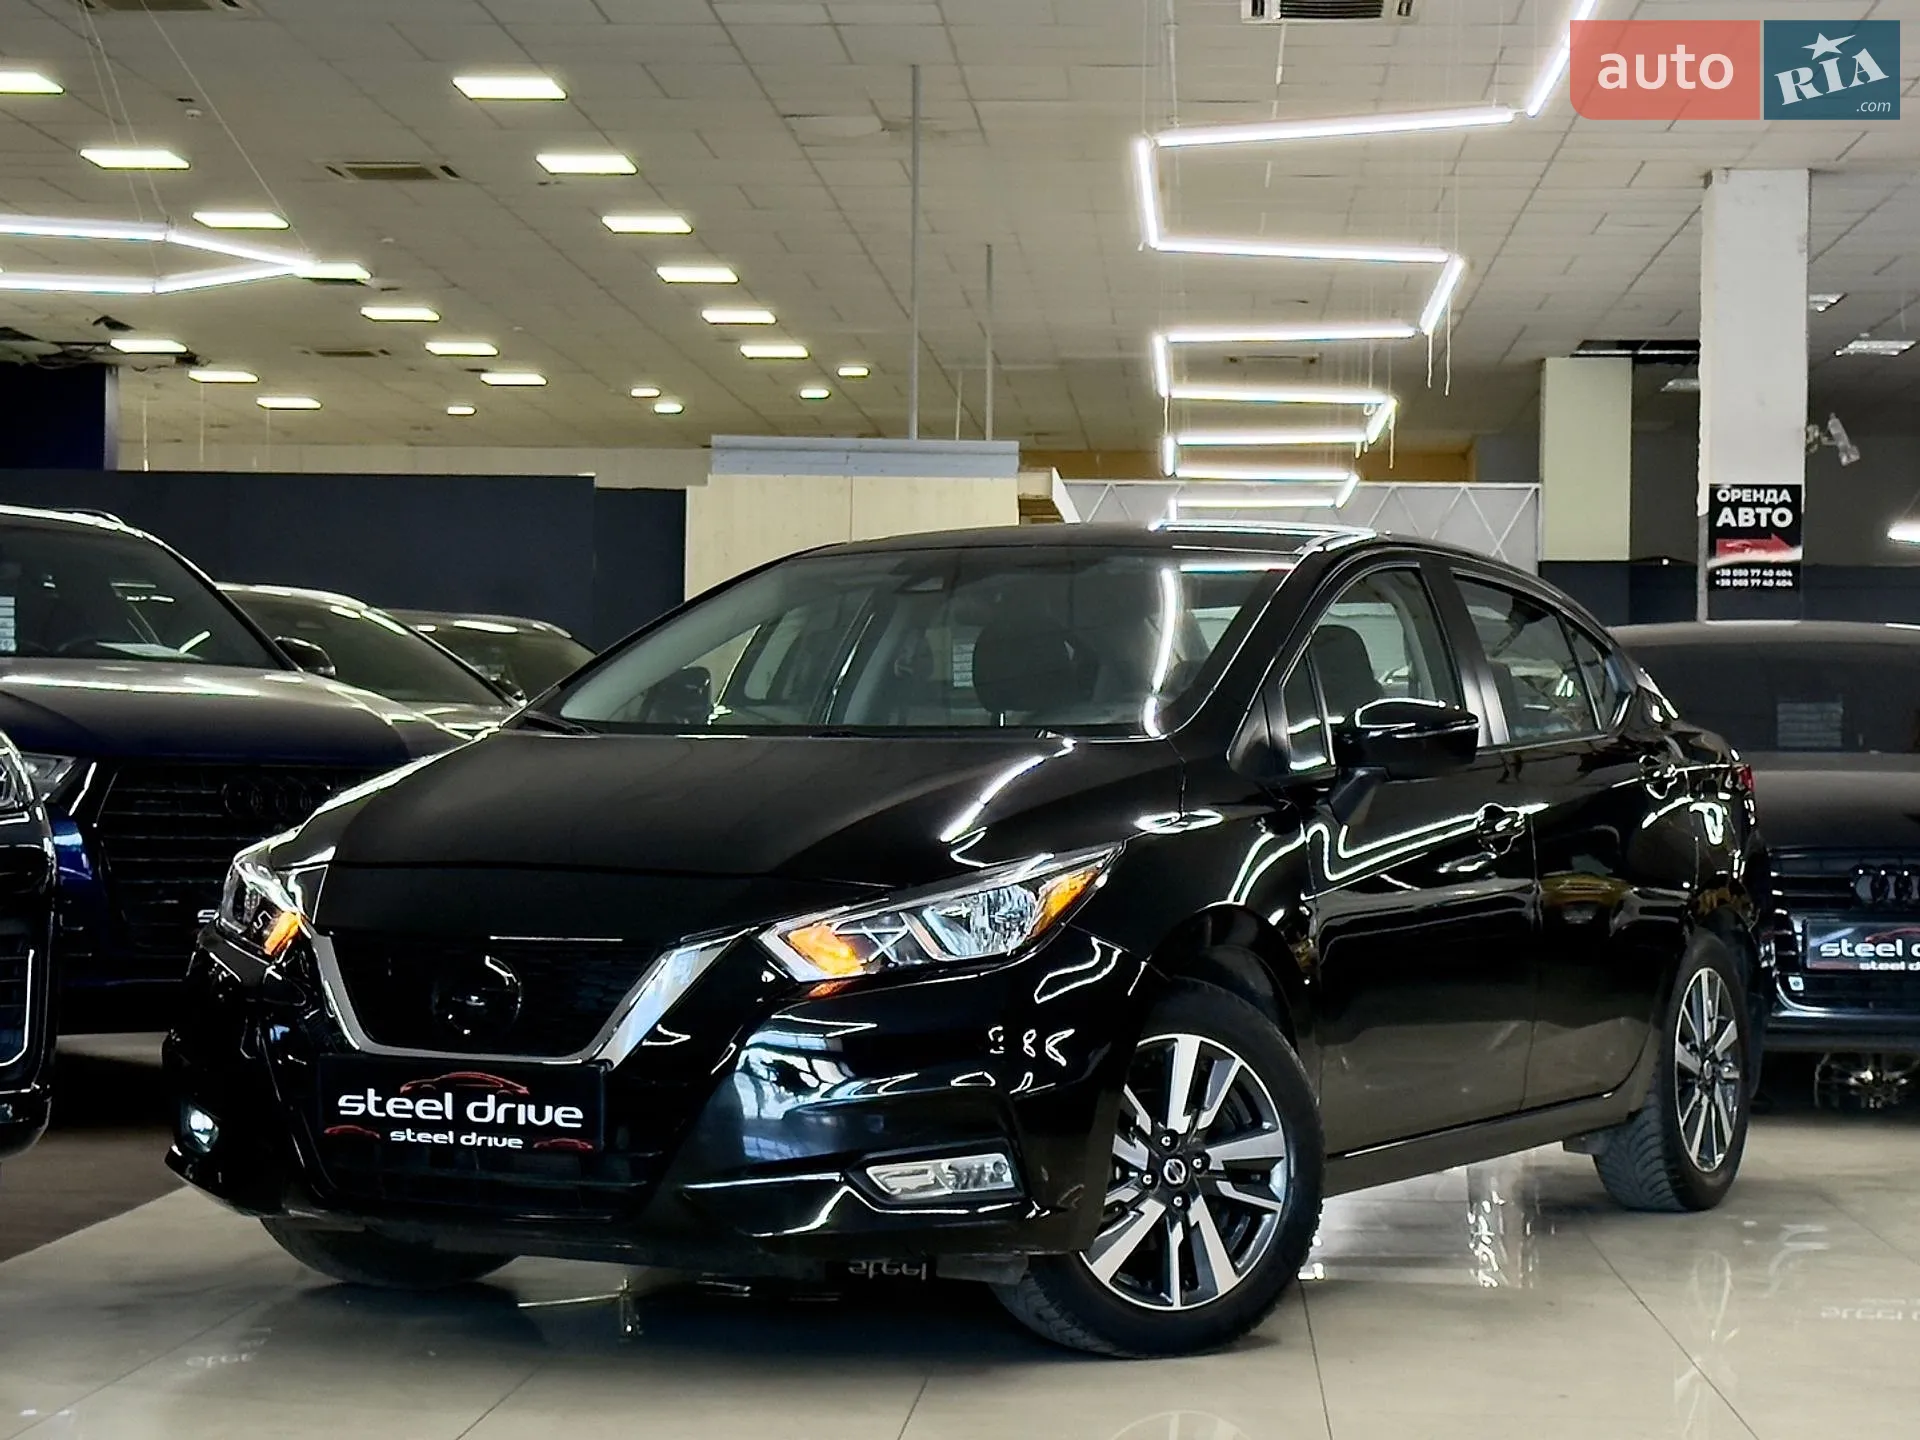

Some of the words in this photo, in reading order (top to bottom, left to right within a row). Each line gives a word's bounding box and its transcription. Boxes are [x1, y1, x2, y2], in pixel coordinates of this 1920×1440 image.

[1716, 488, 1792, 505] ОРЕНДА
[1716, 506, 1793, 528] АВТО
[1750, 568, 1761, 577] 77
[1750, 578, 1761, 587] 77
[1819, 938, 1903, 957] steel
[1859, 961, 1906, 971] steel
[337, 1087, 453, 1121] steel
[466, 1094, 585, 1128] drive
[389, 1128, 454, 1145] steel
[459, 1131, 524, 1149] drive
